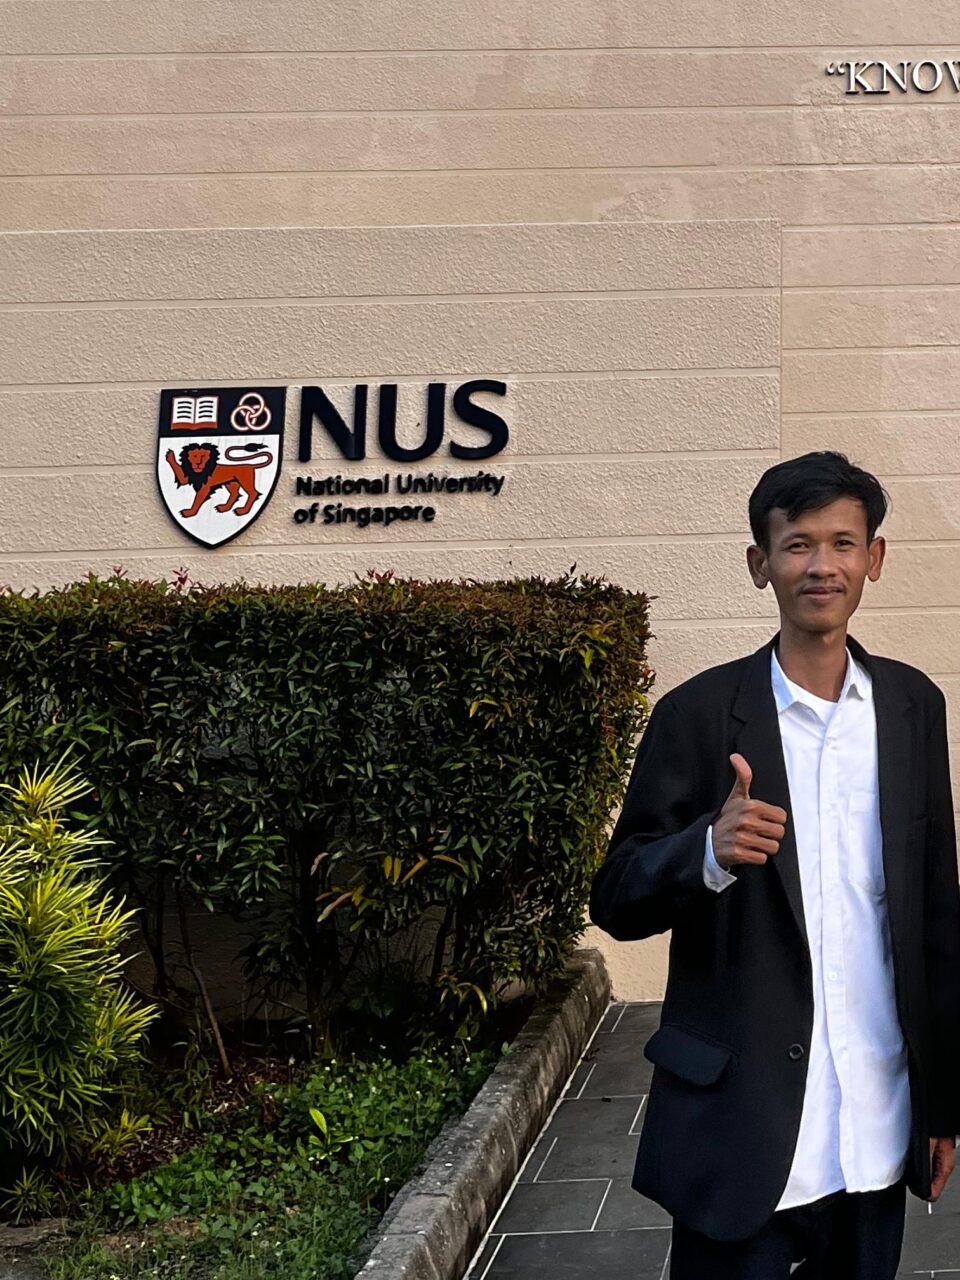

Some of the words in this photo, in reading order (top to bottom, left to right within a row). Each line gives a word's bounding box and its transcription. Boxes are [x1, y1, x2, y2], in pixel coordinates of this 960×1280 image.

[297, 379, 509, 463] NUS
[296, 474, 389, 496] National
[397, 471, 505, 495] University
[293, 503, 321, 524] of
[322, 505, 436, 528] Singapore
